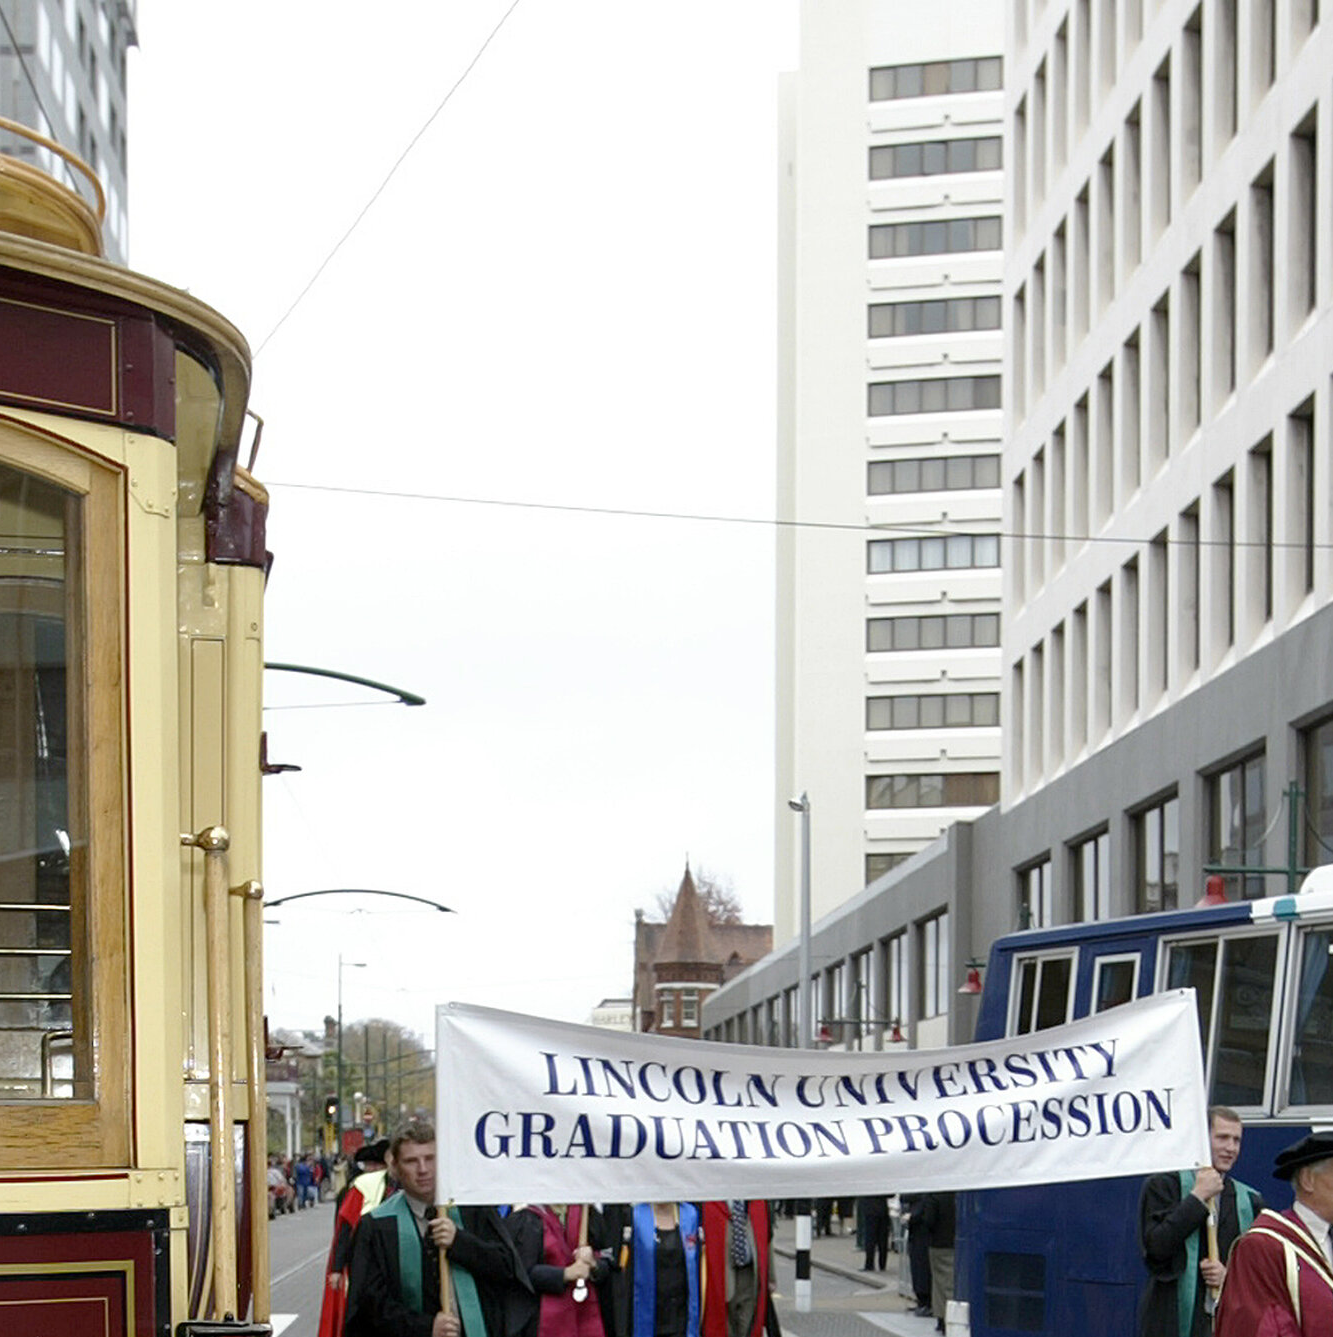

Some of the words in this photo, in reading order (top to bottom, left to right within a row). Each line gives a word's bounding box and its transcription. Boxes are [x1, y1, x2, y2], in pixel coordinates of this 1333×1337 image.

[539, 1051, 784, 1108] LINCOLN
[795, 1038, 1120, 1108] UNIVERSITY
[475, 1110, 850, 1160] GRADUATION
[858, 1087, 1176, 1155] PROCESSION
